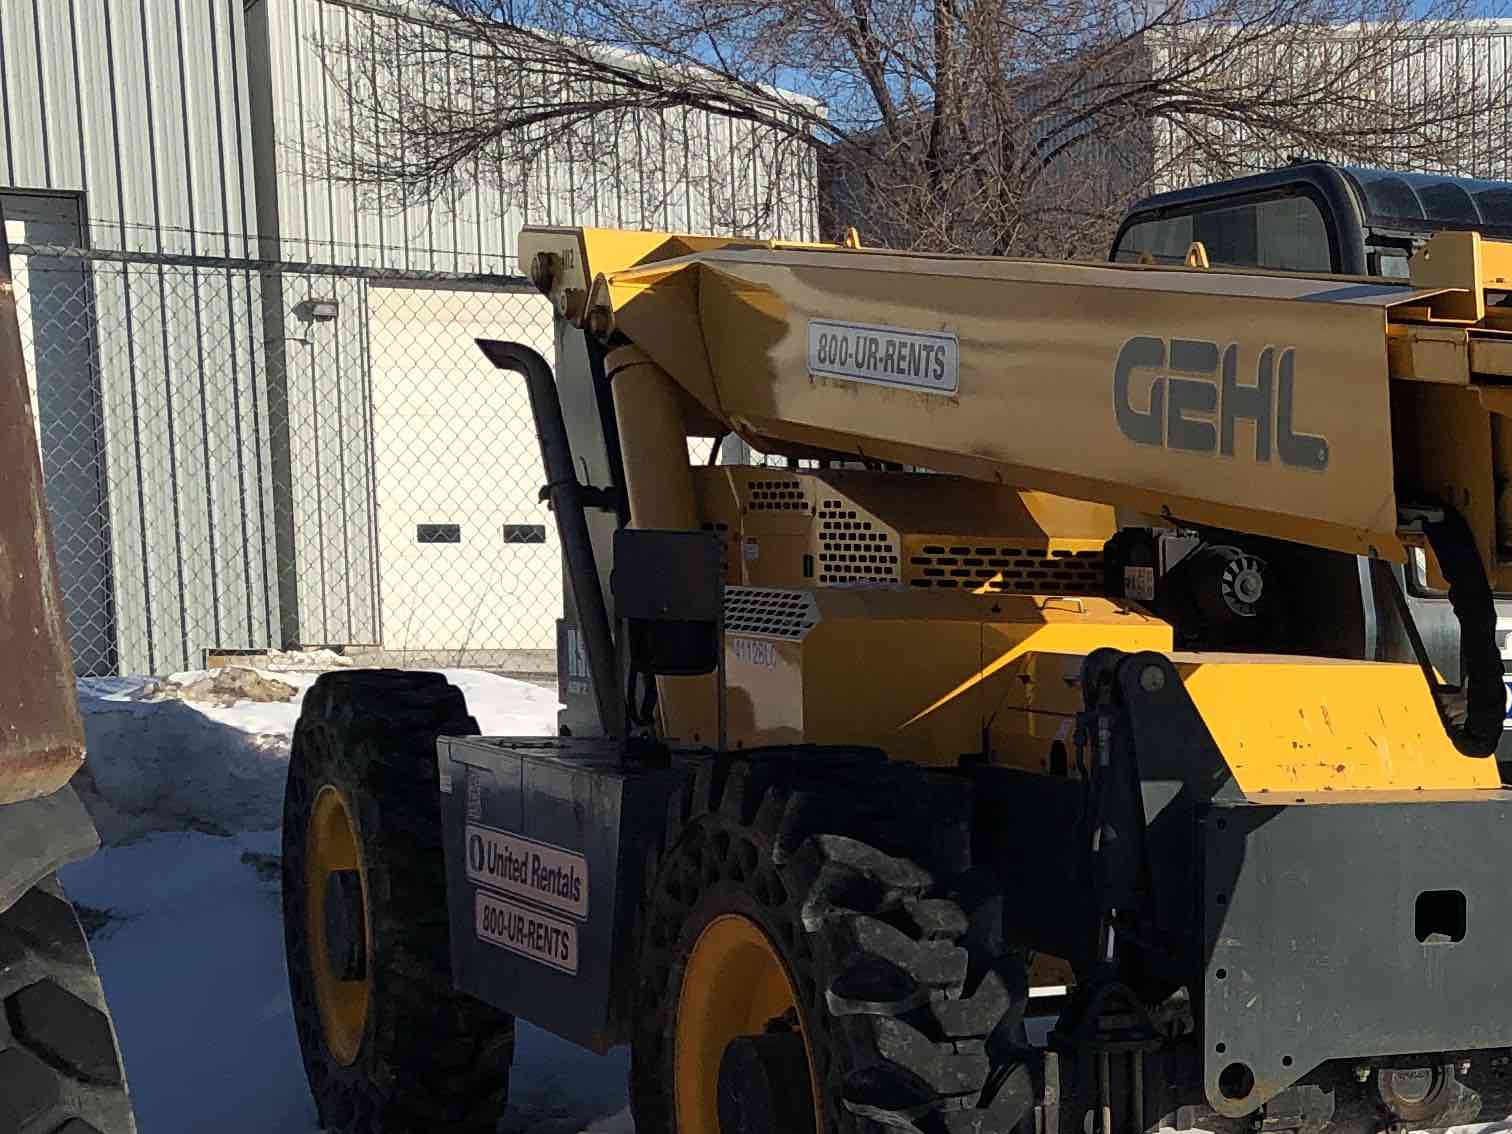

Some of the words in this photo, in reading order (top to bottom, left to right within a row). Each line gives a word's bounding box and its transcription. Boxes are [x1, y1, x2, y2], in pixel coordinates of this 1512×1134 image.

[817, 331, 946, 382] 800-UR-RENTS
[1112, 335, 1329, 472] GEHL
[487, 840, 528, 885] United
[531, 855, 582, 903] Rentals
[482, 904, 570, 961] 800-UR-RENTS
